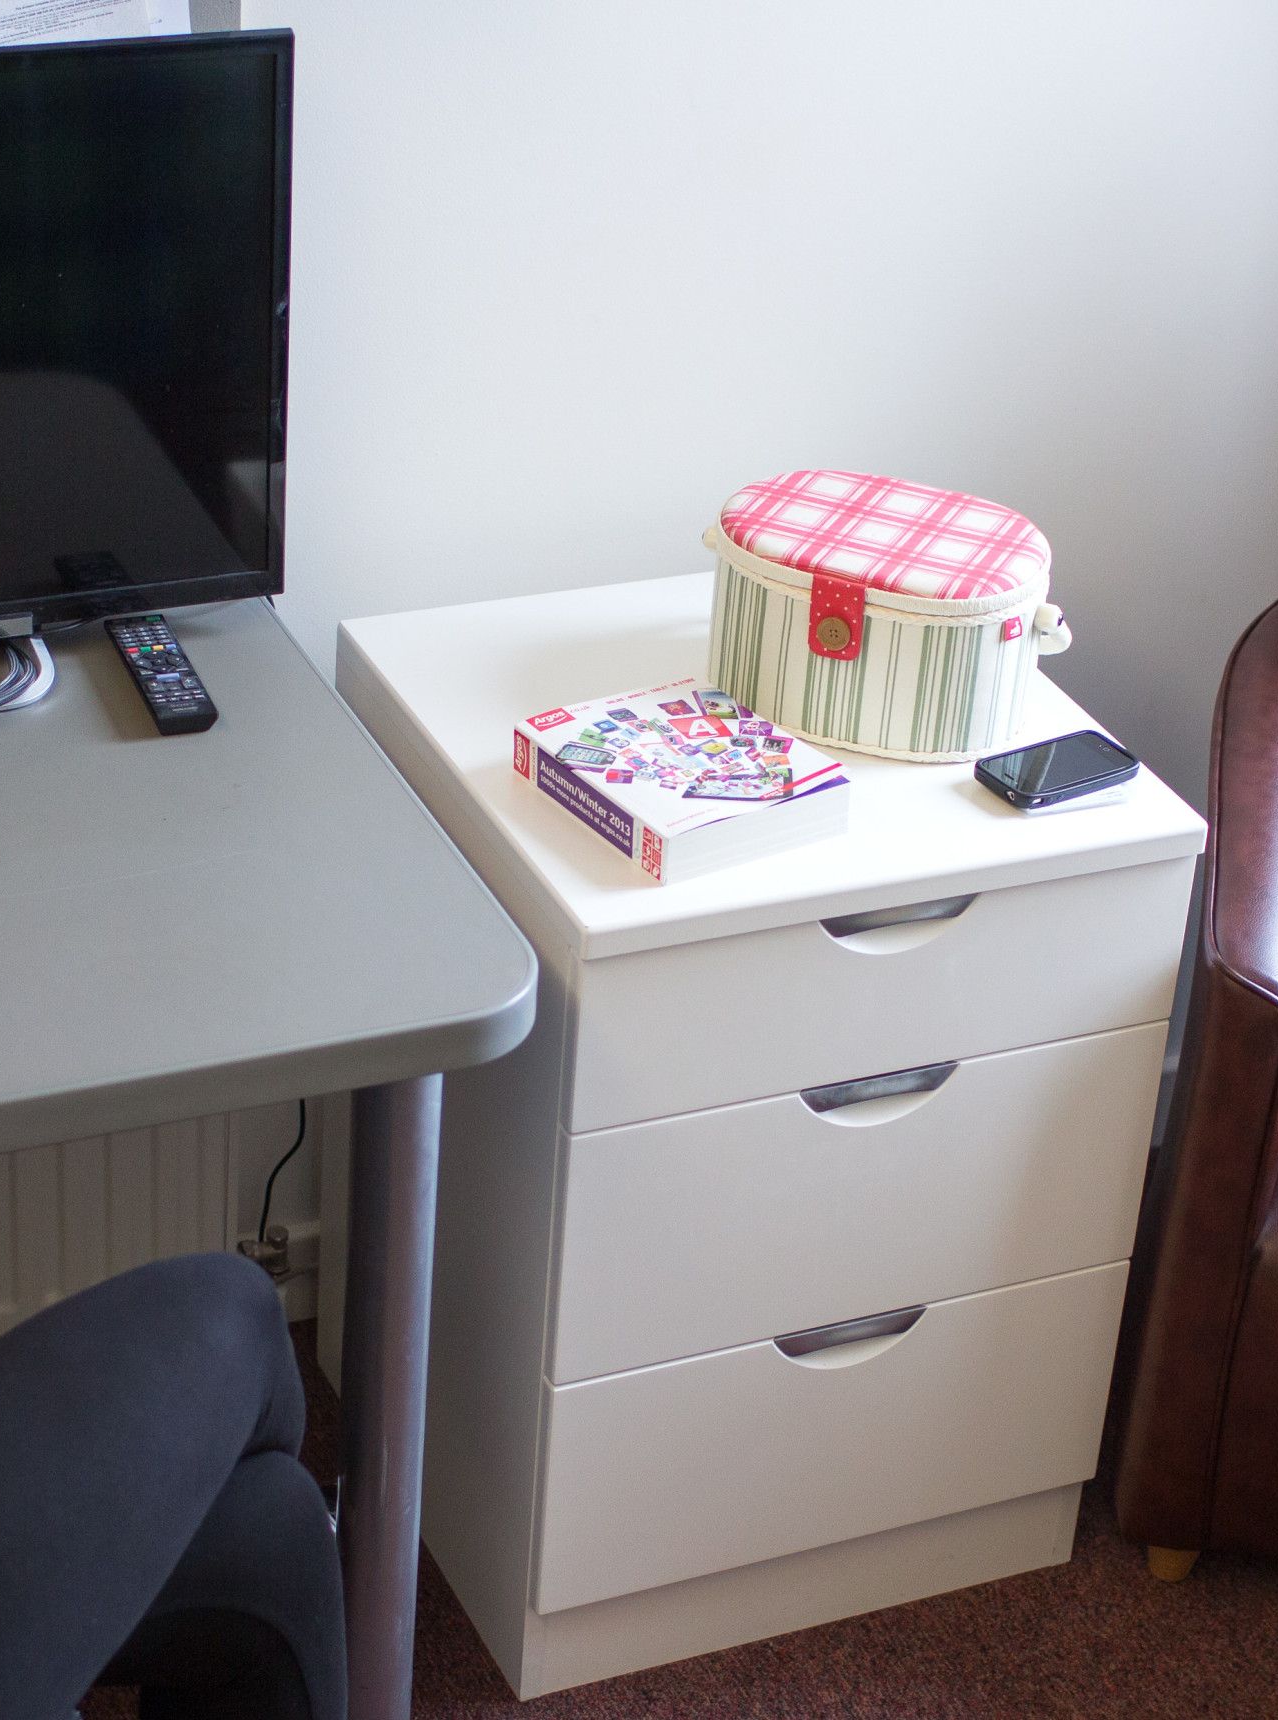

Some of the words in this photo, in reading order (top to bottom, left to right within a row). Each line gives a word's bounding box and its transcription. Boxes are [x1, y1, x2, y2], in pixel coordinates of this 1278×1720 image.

[649, 684, 668, 693] TABLET
[534, 711, 566, 727] Argos
[515, 734, 524, 767] Argos
[540, 760, 607, 819] Autumn/Winter
[608, 812, 631, 837] 2013
[556, 787, 570, 801] more
[570, 799, 594, 820] products
[594, 817, 600, 825] at
[601, 821, 631, 848] argos.co.uk
